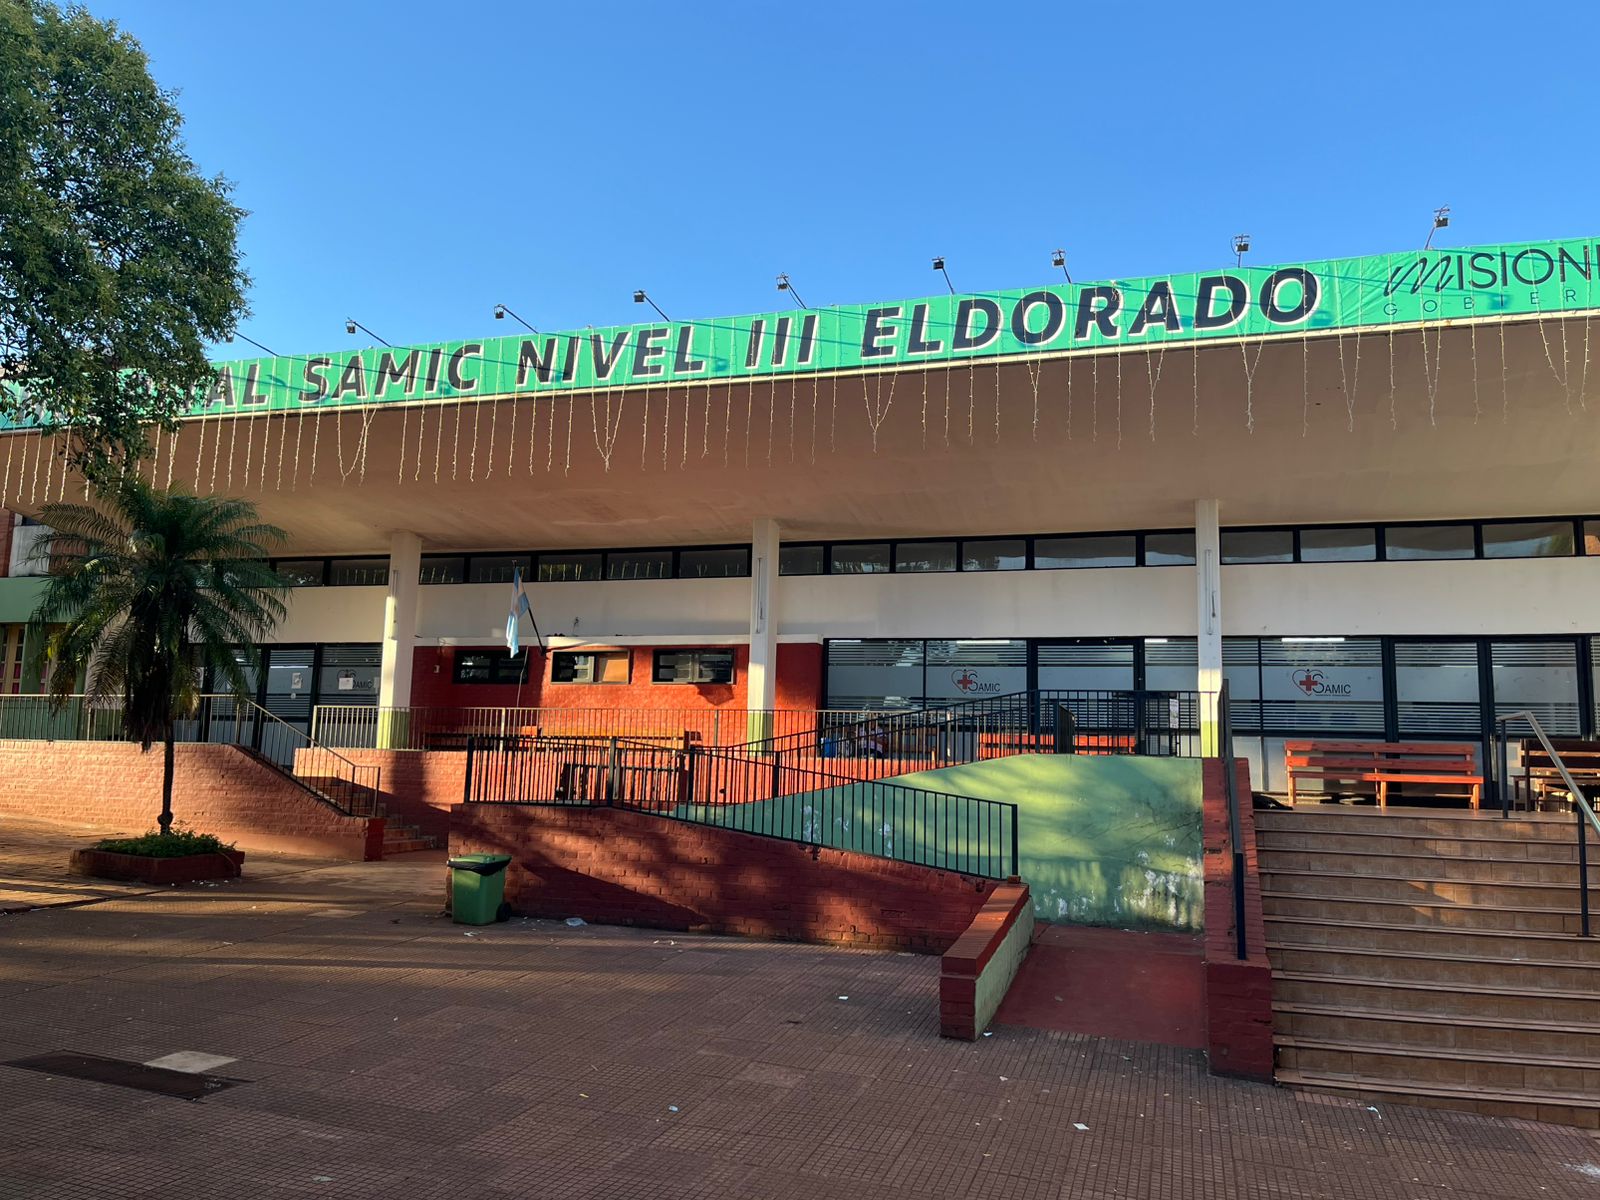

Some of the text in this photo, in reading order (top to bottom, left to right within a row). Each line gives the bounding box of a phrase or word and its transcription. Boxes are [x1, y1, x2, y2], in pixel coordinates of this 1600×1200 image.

[1384, 244, 1600, 297] MISION
[302, 343, 483, 403] SAMIC
[515, 325, 706, 386] NIVEL
[745, 314, 818, 369] III
[861, 267, 1321, 359] ELDORADO
[968, 673, 1000, 692] SAMIC
[1312, 673, 1351, 694] SAMIC
